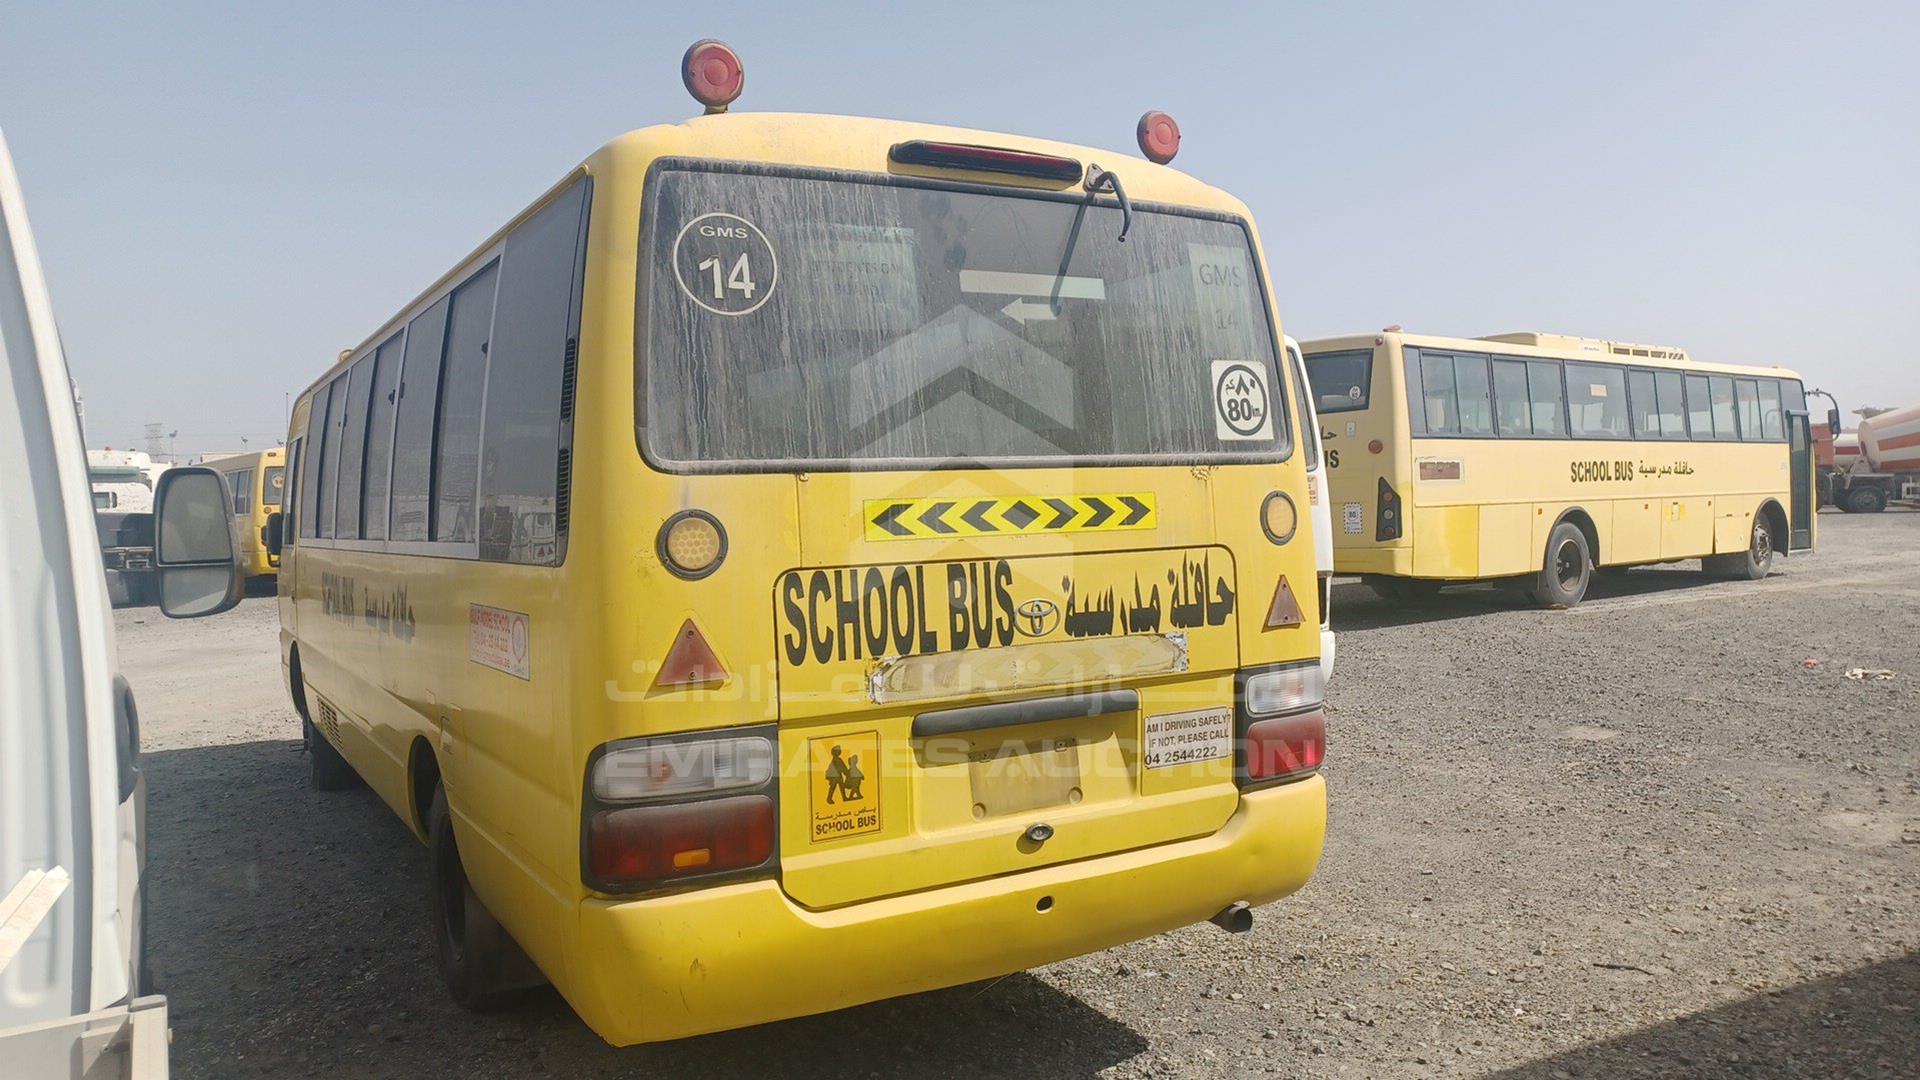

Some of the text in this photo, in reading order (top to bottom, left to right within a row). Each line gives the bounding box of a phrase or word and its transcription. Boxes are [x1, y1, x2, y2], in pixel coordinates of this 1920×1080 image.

[699, 226, 748, 239] GMS
[698, 252, 756, 299] 14
[1198, 263, 1241, 287] GMS
[1227, 398, 1252, 422] 80
[1570, 460, 1634, 483] SCHOOL BUS
[1638, 459, 1695, 479] حافلة مدرسية
[1168, 550, 1236, 629] حافلة
[783, 558, 1017, 667] SCHOOL BUS
[1146, 723, 1158, 734] AM
[1165, 719, 1197, 731] DRIVING
[1198, 714, 1231, 727] SAFELY?
[1150, 728, 1229, 748] IF NOT, PLEASE CALL
[1145, 746, 1218, 766] 04 2544222
[815, 815, 877, 835] SCHOOL BUS
